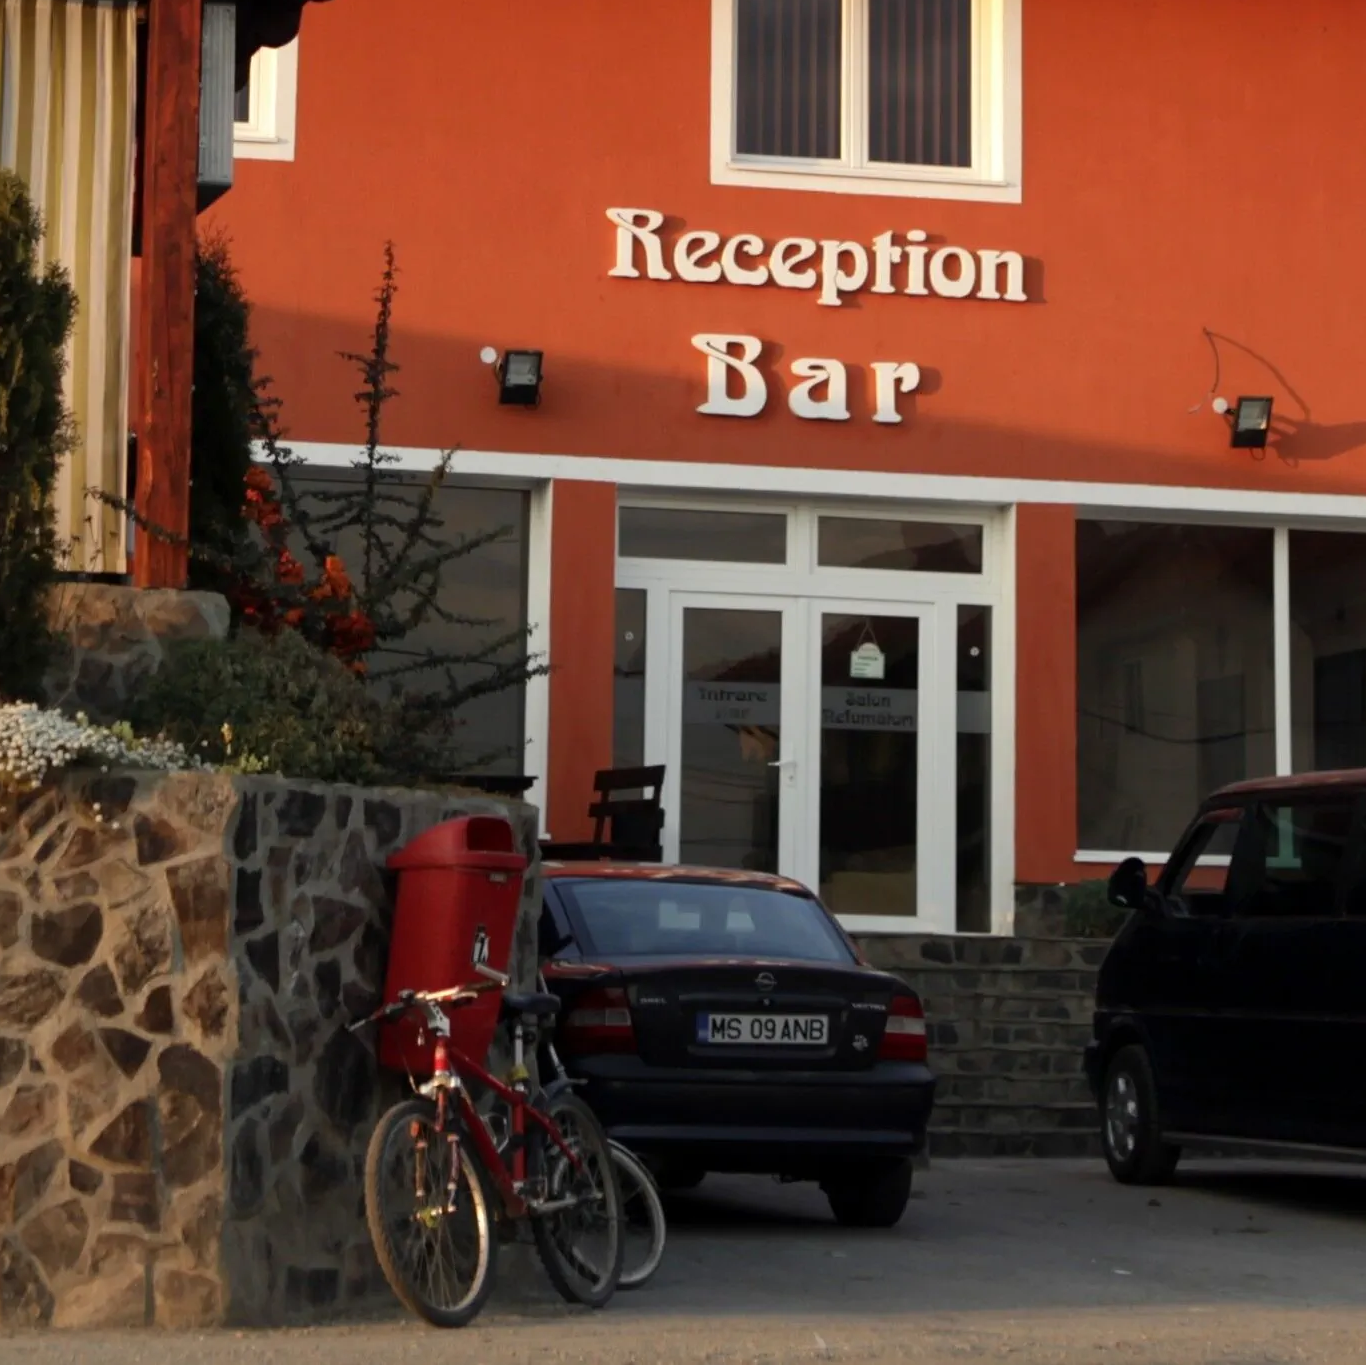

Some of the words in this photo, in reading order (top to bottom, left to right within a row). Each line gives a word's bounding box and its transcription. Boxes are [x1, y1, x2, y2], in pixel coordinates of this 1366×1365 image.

[605, 206, 1029, 307] Reception
[691, 332, 921, 424] Bar
[711, 1017, 742, 1040] MS
[749, 1018, 776, 1040] 09
[780, 1018, 825, 1041] ANB
